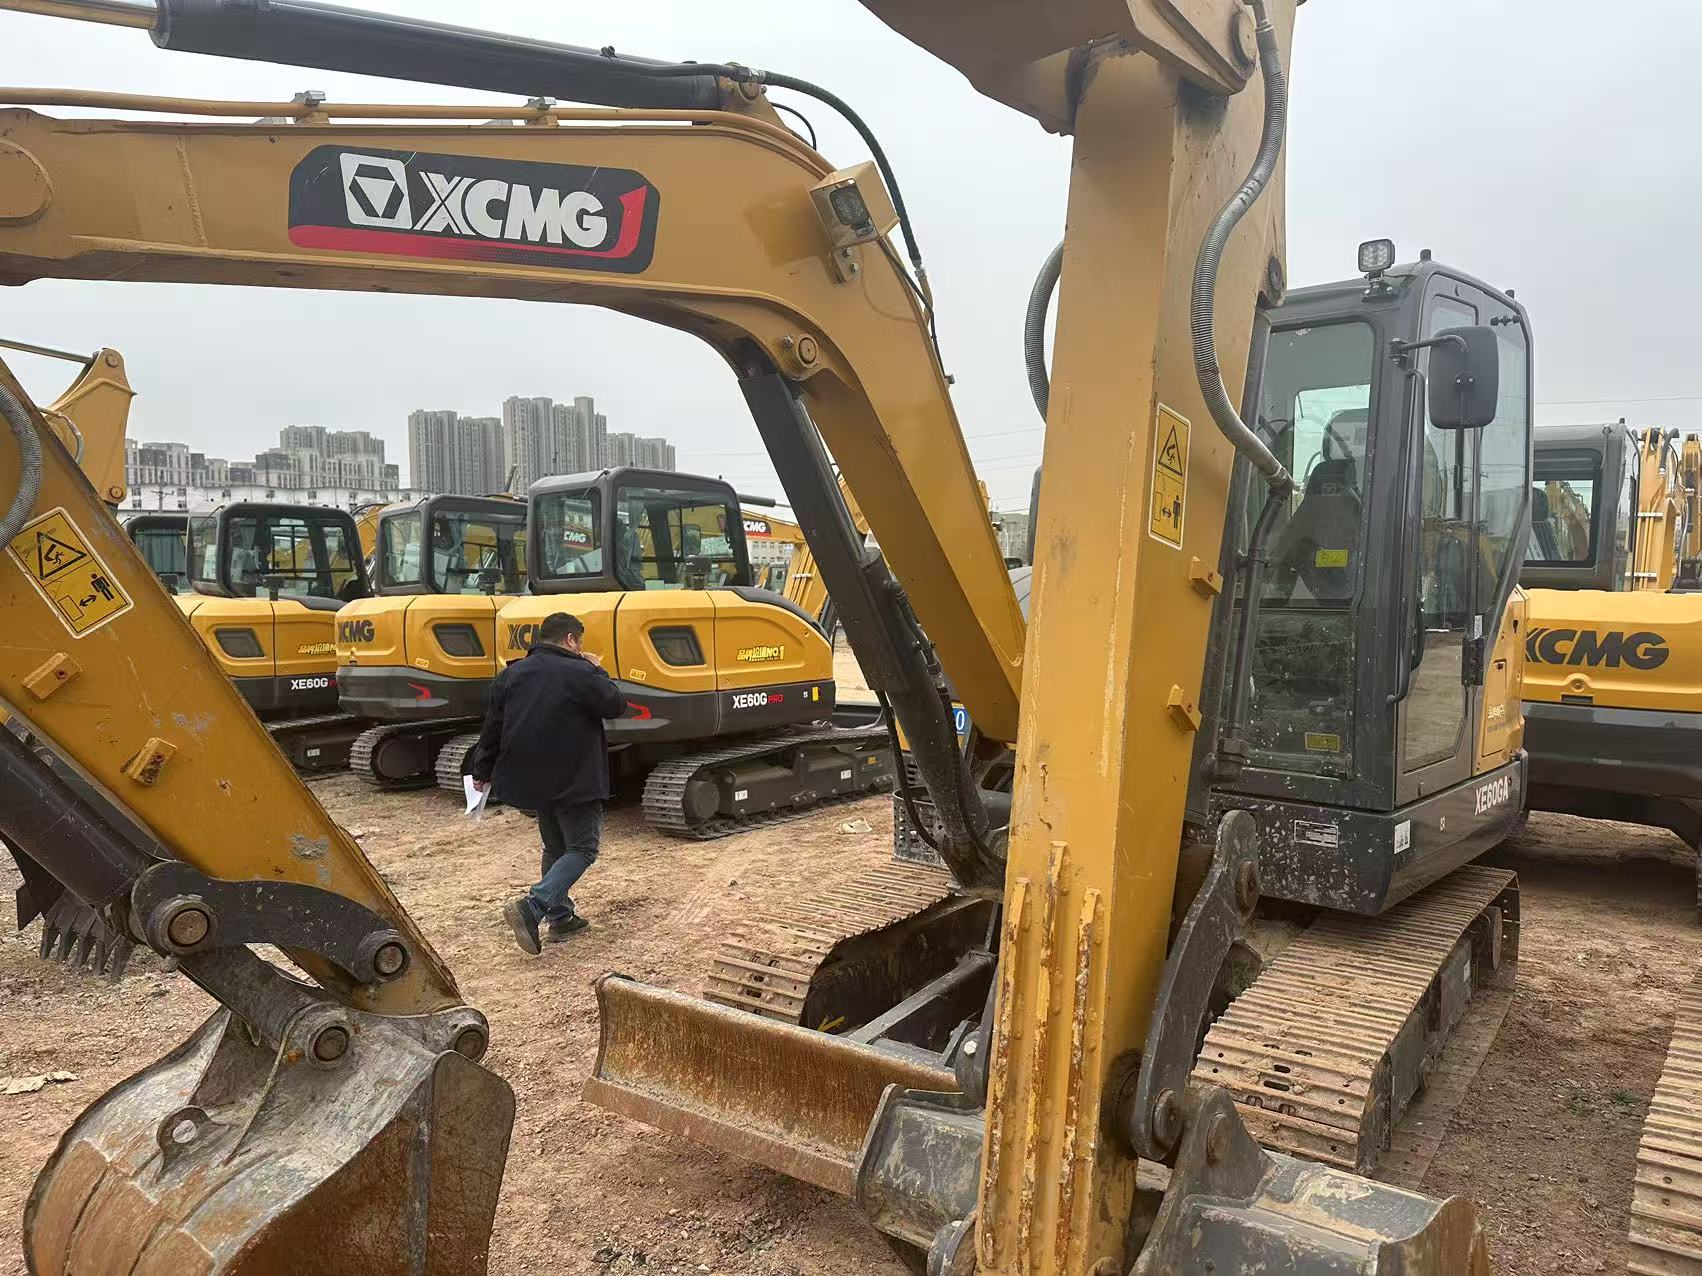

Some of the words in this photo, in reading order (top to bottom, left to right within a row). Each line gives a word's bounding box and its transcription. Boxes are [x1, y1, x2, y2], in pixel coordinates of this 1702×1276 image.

[413, 171, 608, 248] XCMG
[743, 520, 767, 533] CMG
[291, 678, 328, 690] XE60G
[733, 692, 767, 709] XE60G
[768, 694, 784, 704] PRO
[1474, 775, 1509, 816] XE60GA
